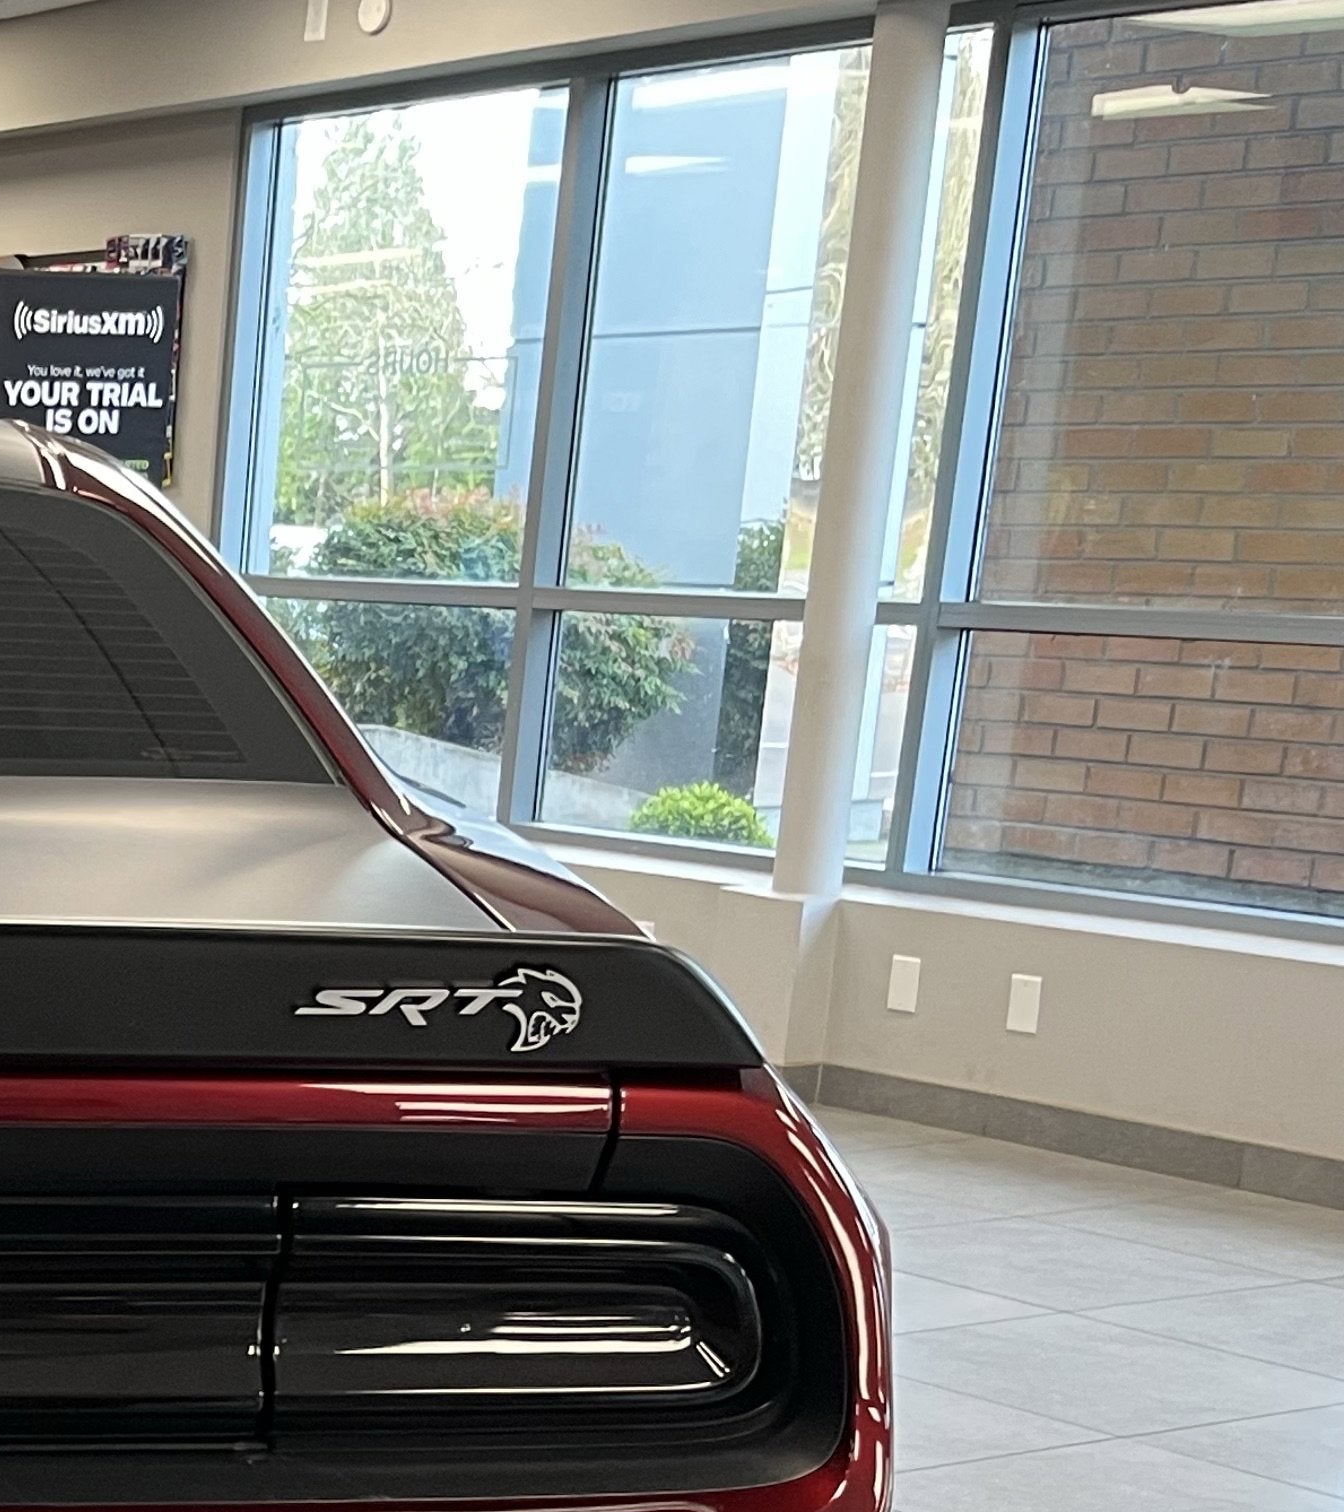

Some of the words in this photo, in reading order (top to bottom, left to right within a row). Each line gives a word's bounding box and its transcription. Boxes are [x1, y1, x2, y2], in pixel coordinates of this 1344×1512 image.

[27, 365, 48, 376] You
[50, 365, 72, 377] love
[86, 366, 116, 378] we've
[117, 367, 135, 380] got
[138, 367, 146, 378] it
[4, 380, 80, 407] YOUR
[86, 382, 163, 408] TRIAL
[45, 409, 72, 434] IS
[77, 409, 120, 434] ON
[294, 989, 523, 1026] SRT
